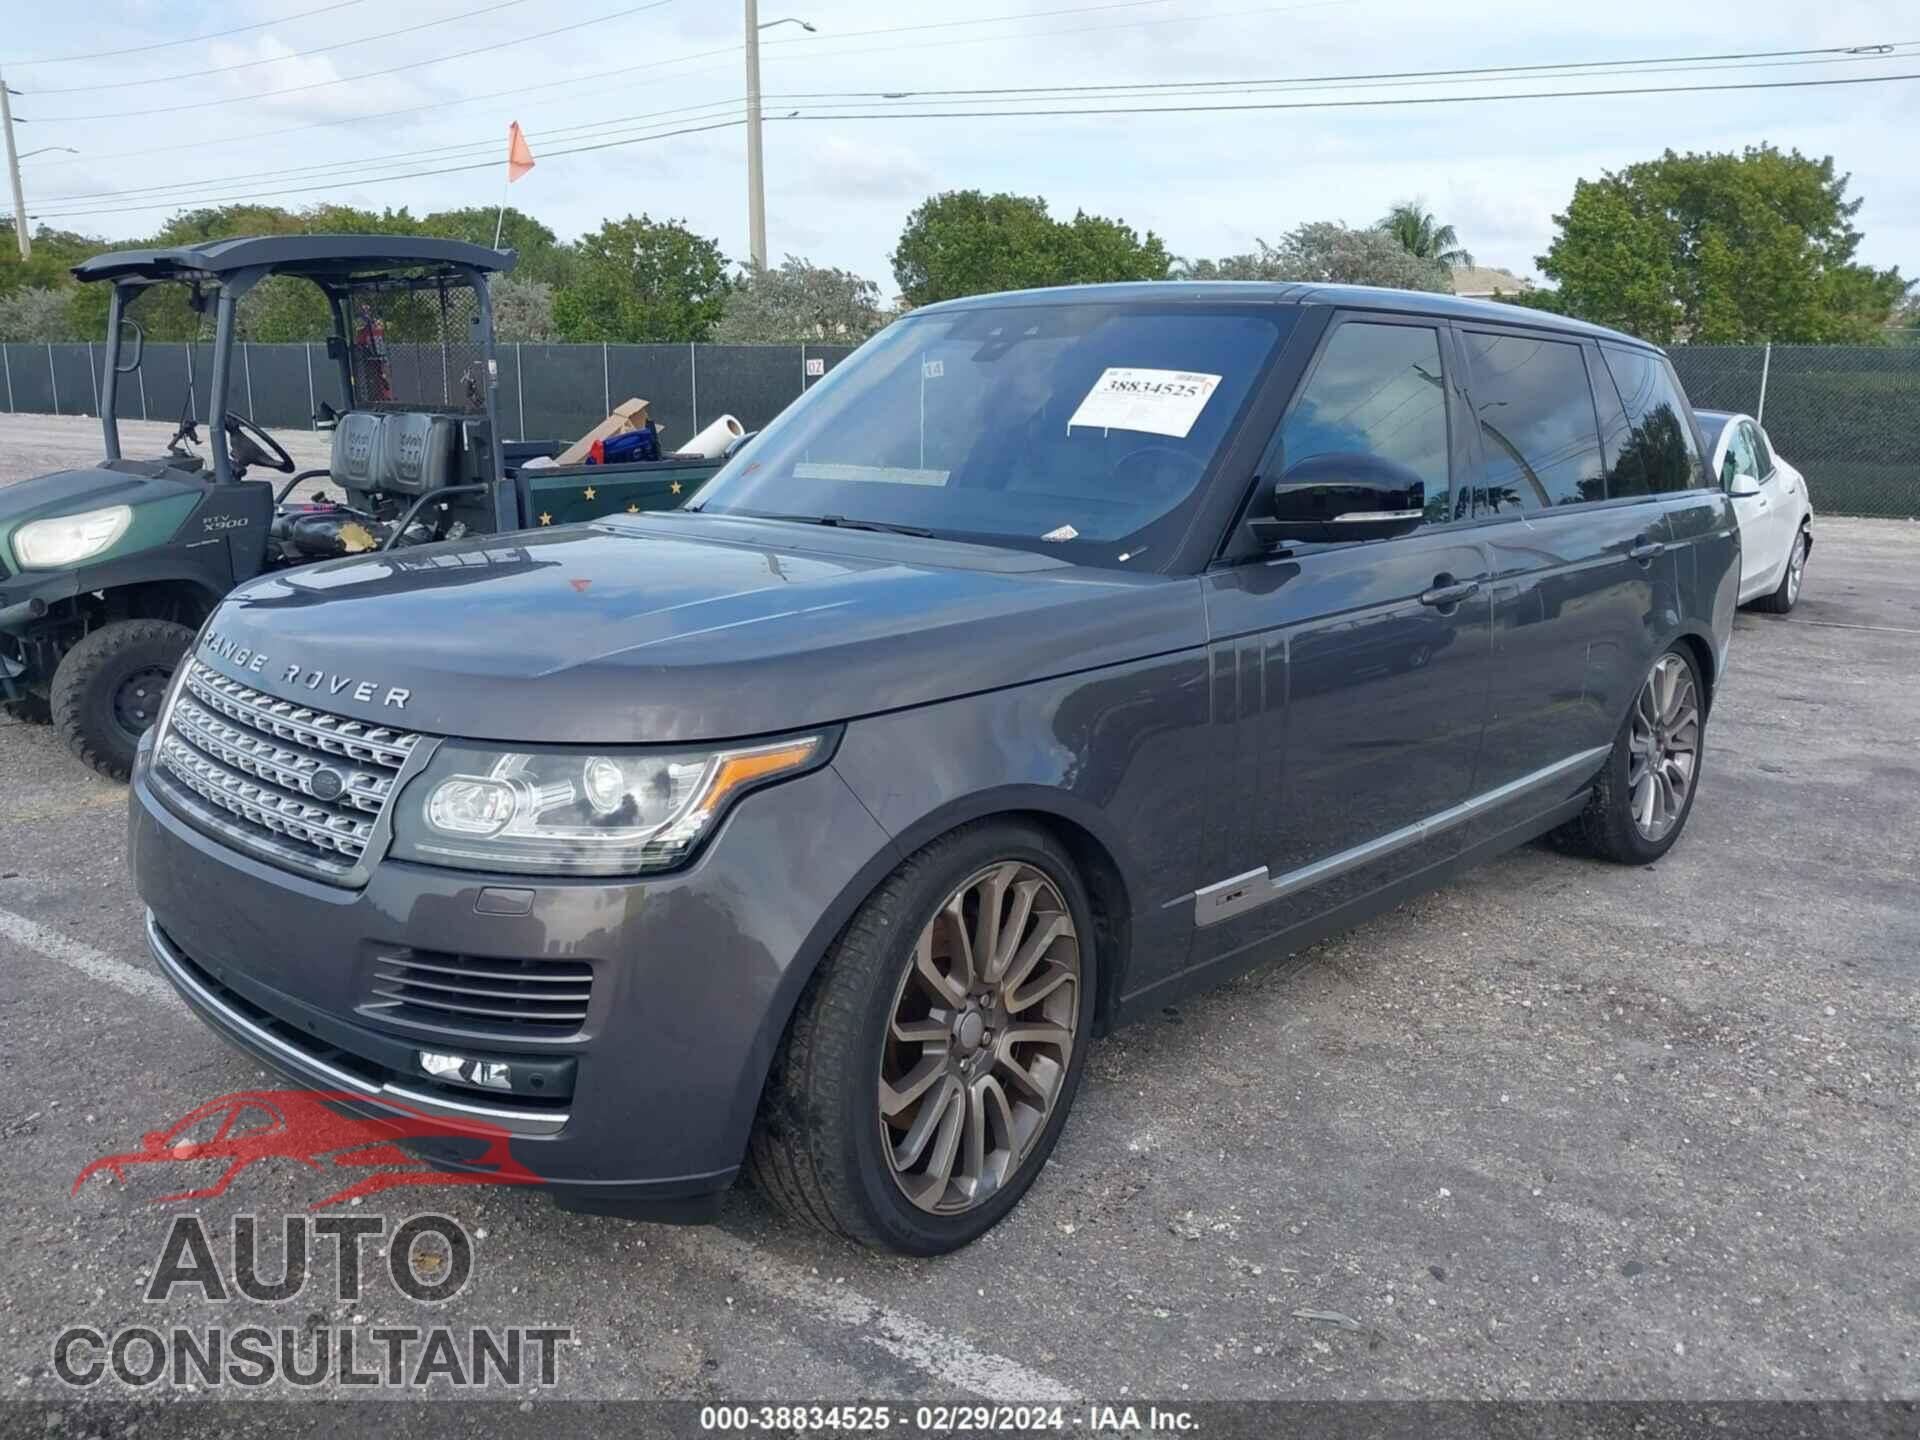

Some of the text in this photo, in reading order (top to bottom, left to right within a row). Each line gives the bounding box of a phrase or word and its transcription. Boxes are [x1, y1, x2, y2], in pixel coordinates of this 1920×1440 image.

[1105, 379, 1199, 397] 38834525
[203, 517, 249, 532] X900
[202, 629, 411, 709] RANGE ROVER
